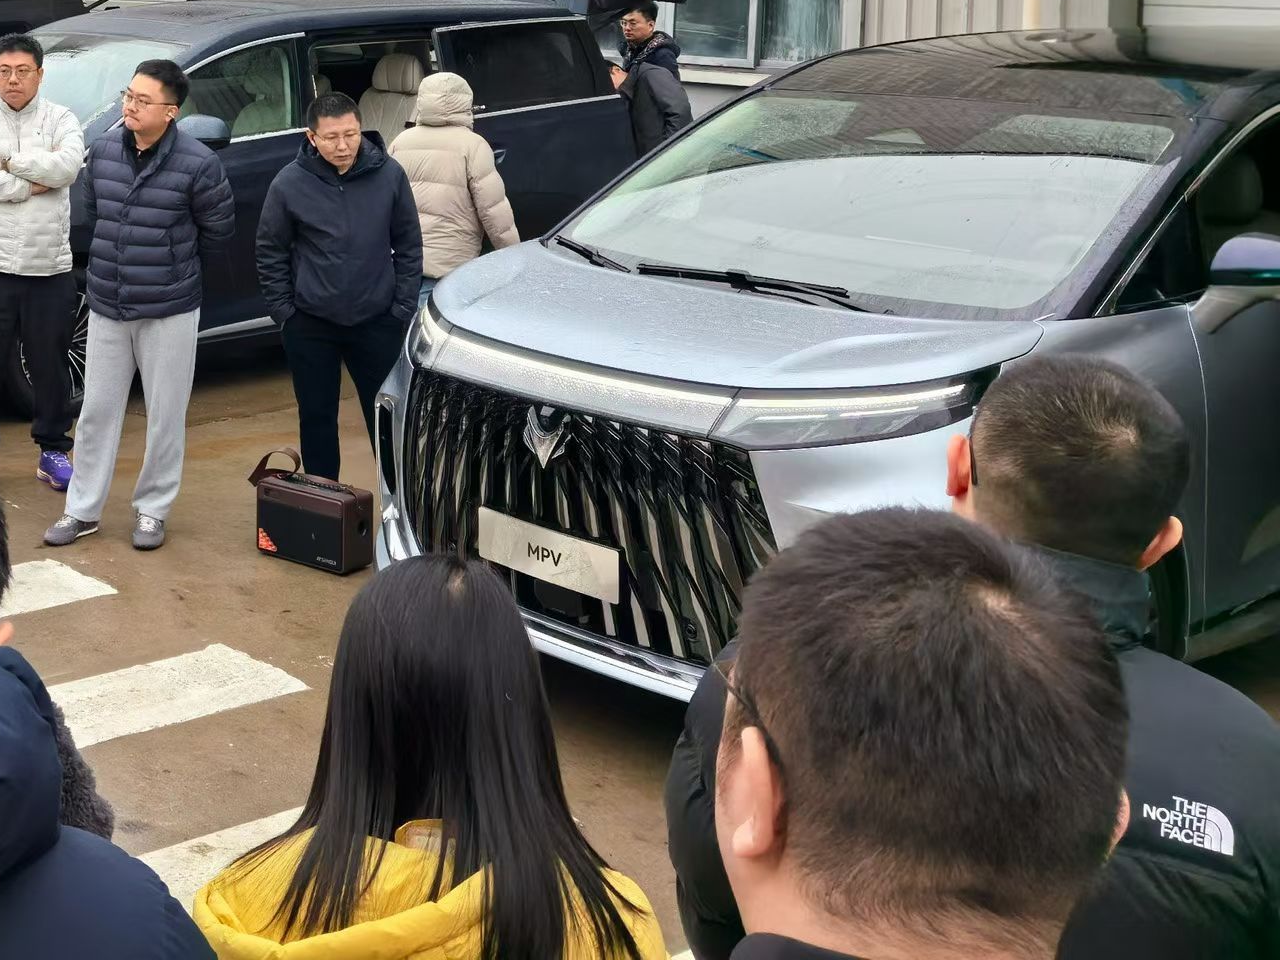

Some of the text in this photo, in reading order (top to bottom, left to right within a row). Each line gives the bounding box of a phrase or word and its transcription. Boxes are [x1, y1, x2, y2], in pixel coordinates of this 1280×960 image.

[527, 542, 562, 567] MPV
[1143, 803, 1206, 833] NORTH
[1172, 795, 1207, 819] THE
[1160, 822, 1205, 848] FACE
